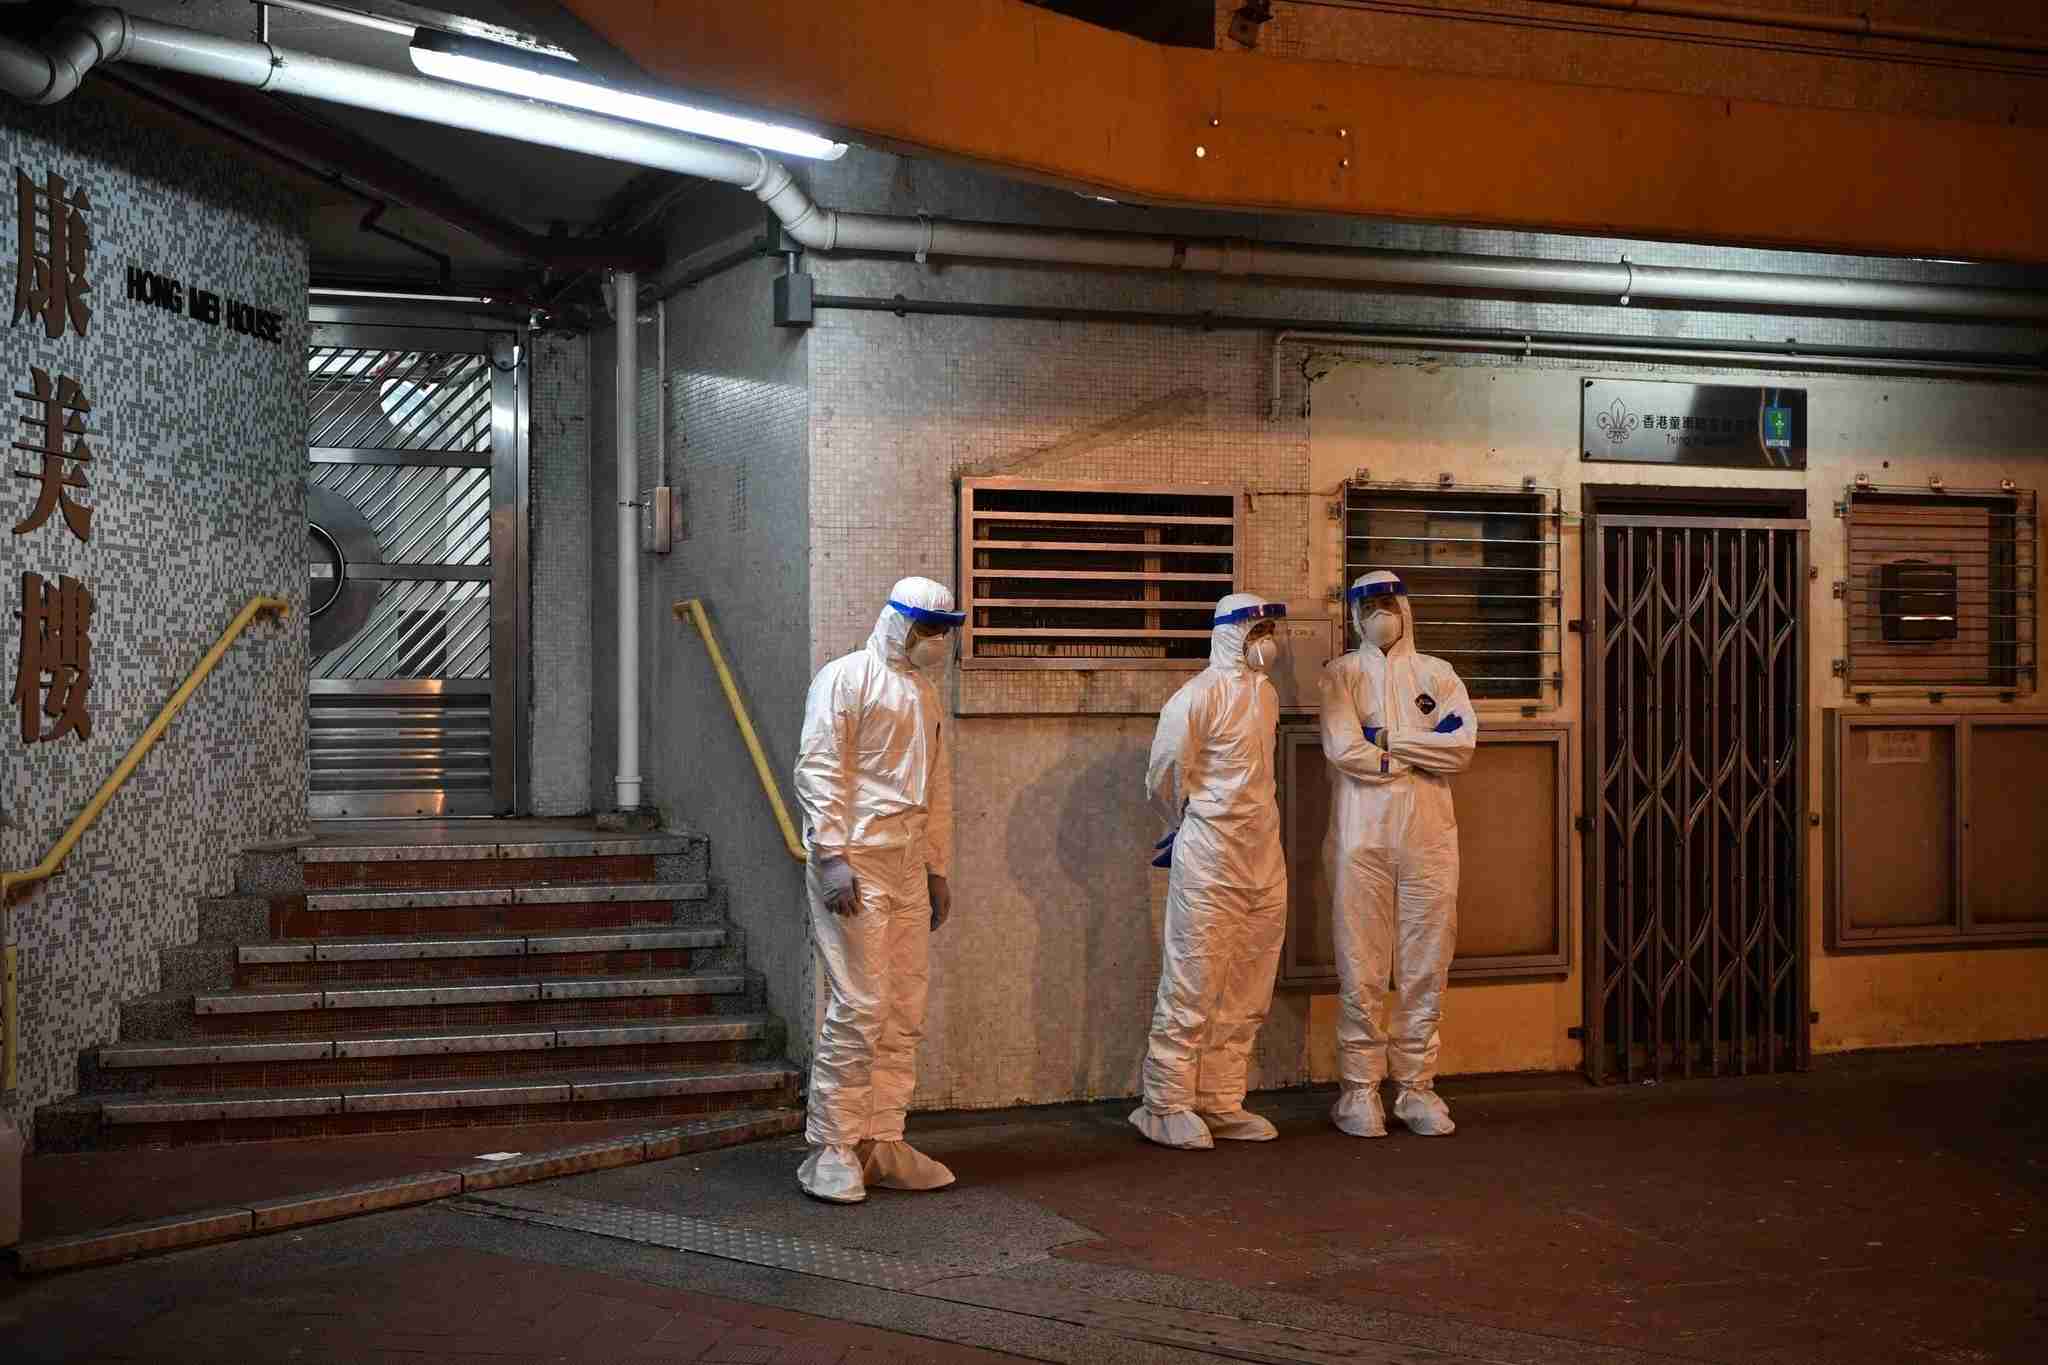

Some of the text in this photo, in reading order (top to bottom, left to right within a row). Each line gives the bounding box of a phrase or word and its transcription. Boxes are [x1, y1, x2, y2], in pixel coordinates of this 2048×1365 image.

[11, 166, 94, 744] 康美樓
[127, 265, 182, 313] HONG
[226, 299, 282, 344] HOUSE
